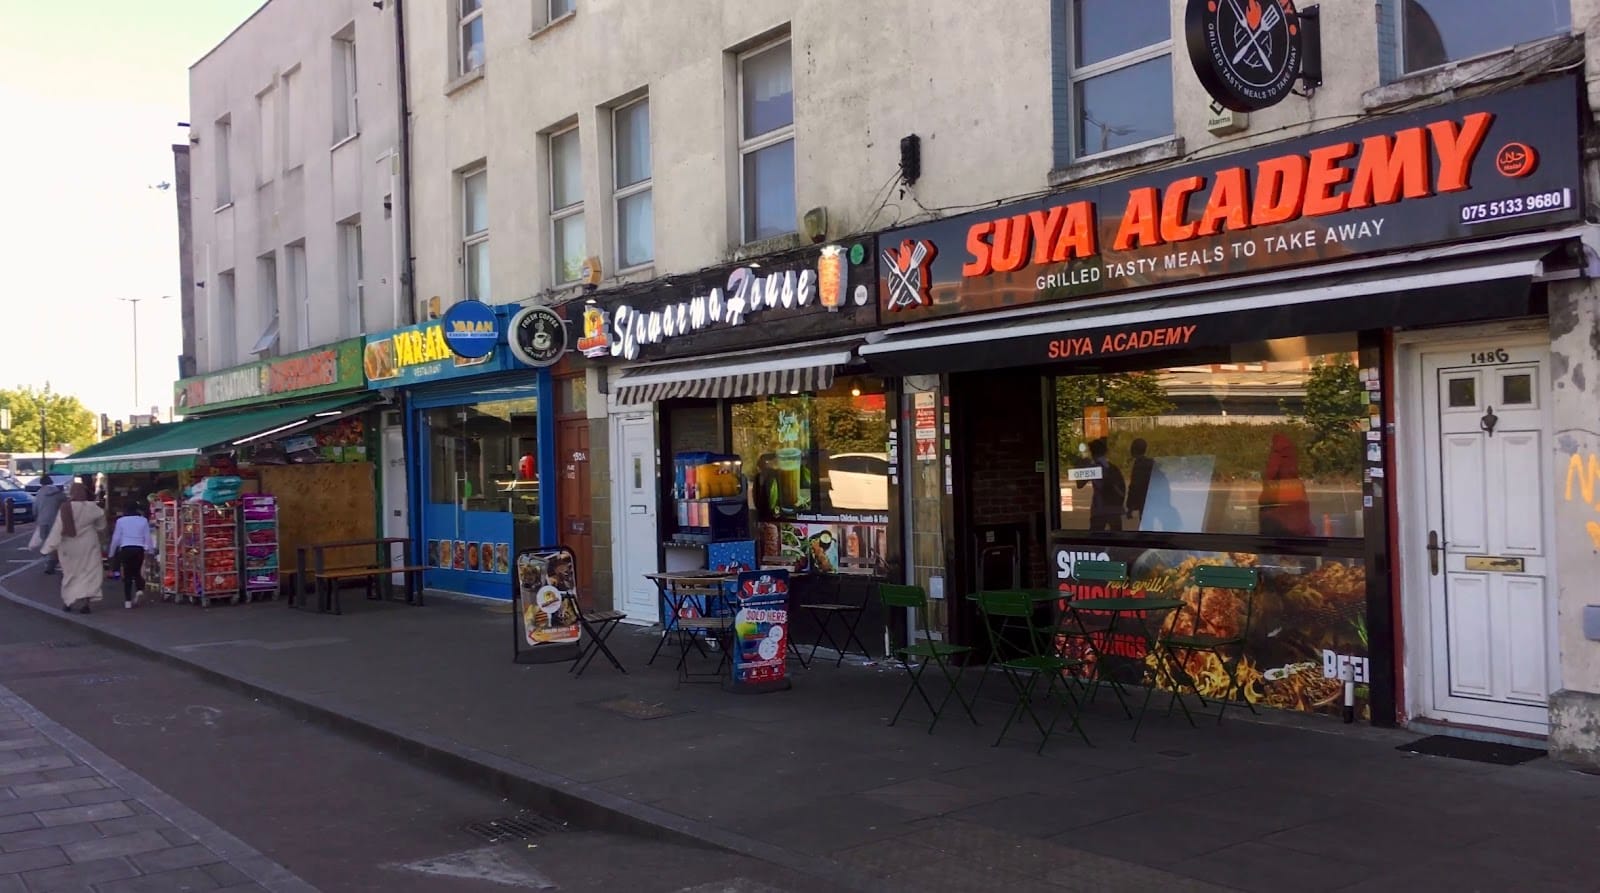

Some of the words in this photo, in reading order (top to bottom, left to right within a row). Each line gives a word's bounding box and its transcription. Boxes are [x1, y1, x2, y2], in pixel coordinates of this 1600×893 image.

[1223, 67, 1243, 91] TASTY
[1243, 87, 1267, 99] MEALS
[1268, 87, 1277, 97] TO
[1276, 72, 1291, 91] TAKE
[1288, 47, 1298, 71] AWAY
[962, 200, 1098, 278] SUYA
[1113, 112, 1494, 250] ACADEMY
[1462, 204, 1487, 220] 075
[1490, 197, 1523, 216] 5133
[1526, 191, 1561, 210] 9680
[1036, 266, 1100, 291] GRILLED
[1106, 256, 1158, 279] TASTY
[1164, 245, 1225, 270] MEALS
[1232, 240, 1257, 259] TO
[1264, 230, 1317, 254] TAKE
[1324, 218, 1385, 245] AWAY
[1048, 336, 1093, 358] SUYA
[1101, 325, 1197, 353] ACADEMY
[1073, 469, 1097, 479] OPEN
[1130, 576, 1170, 595] grill!
